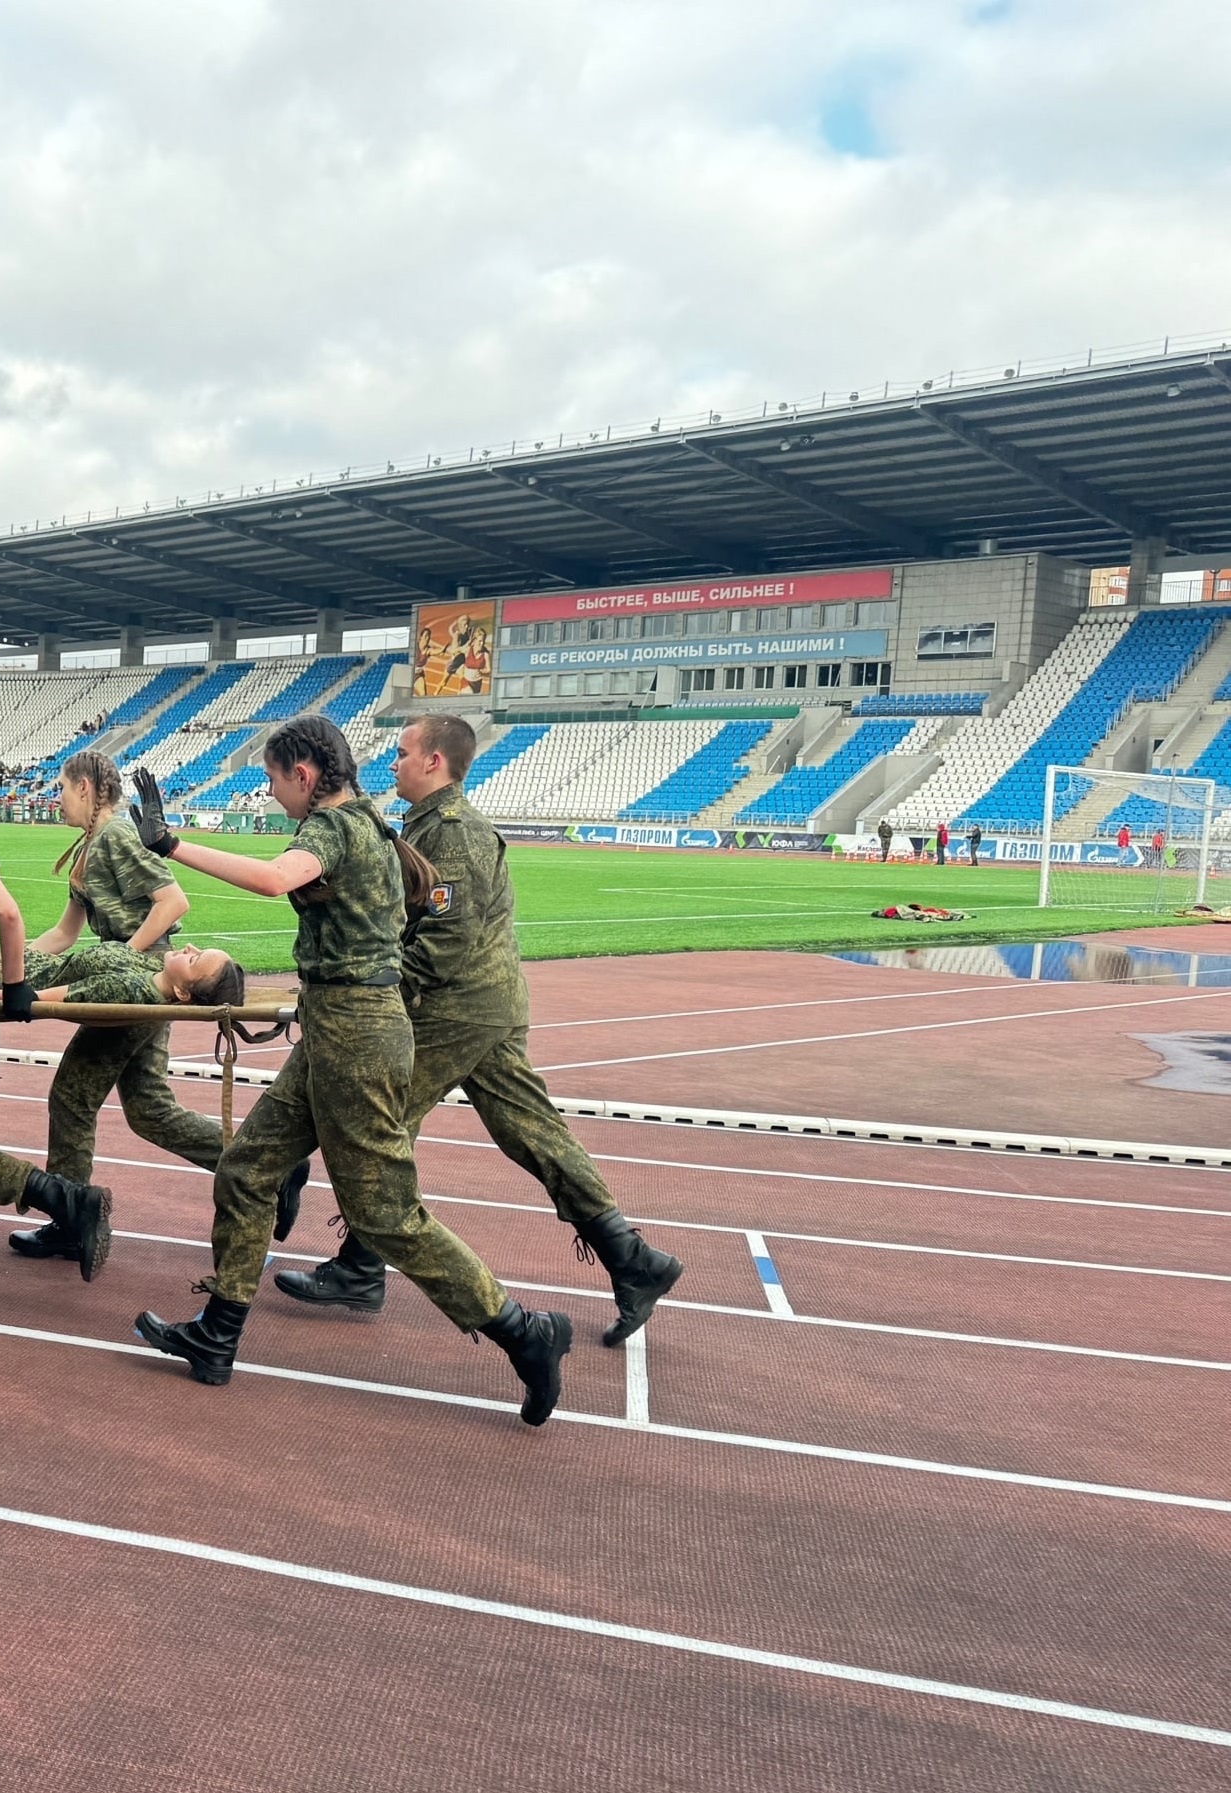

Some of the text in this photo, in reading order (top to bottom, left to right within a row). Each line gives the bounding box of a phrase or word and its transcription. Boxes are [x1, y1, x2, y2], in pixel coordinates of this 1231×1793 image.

[576, 583, 794, 610] БЫСТРЕЕ, ВЫШЕ, СИЛЬНЕЕ !
[530, 638, 845, 665] ВСЕ РЕКОРДЫ ДОЛЖНЫ БЫТЬ НАШИМИ !
[620, 828, 672, 845] ГАЗПРОМ
